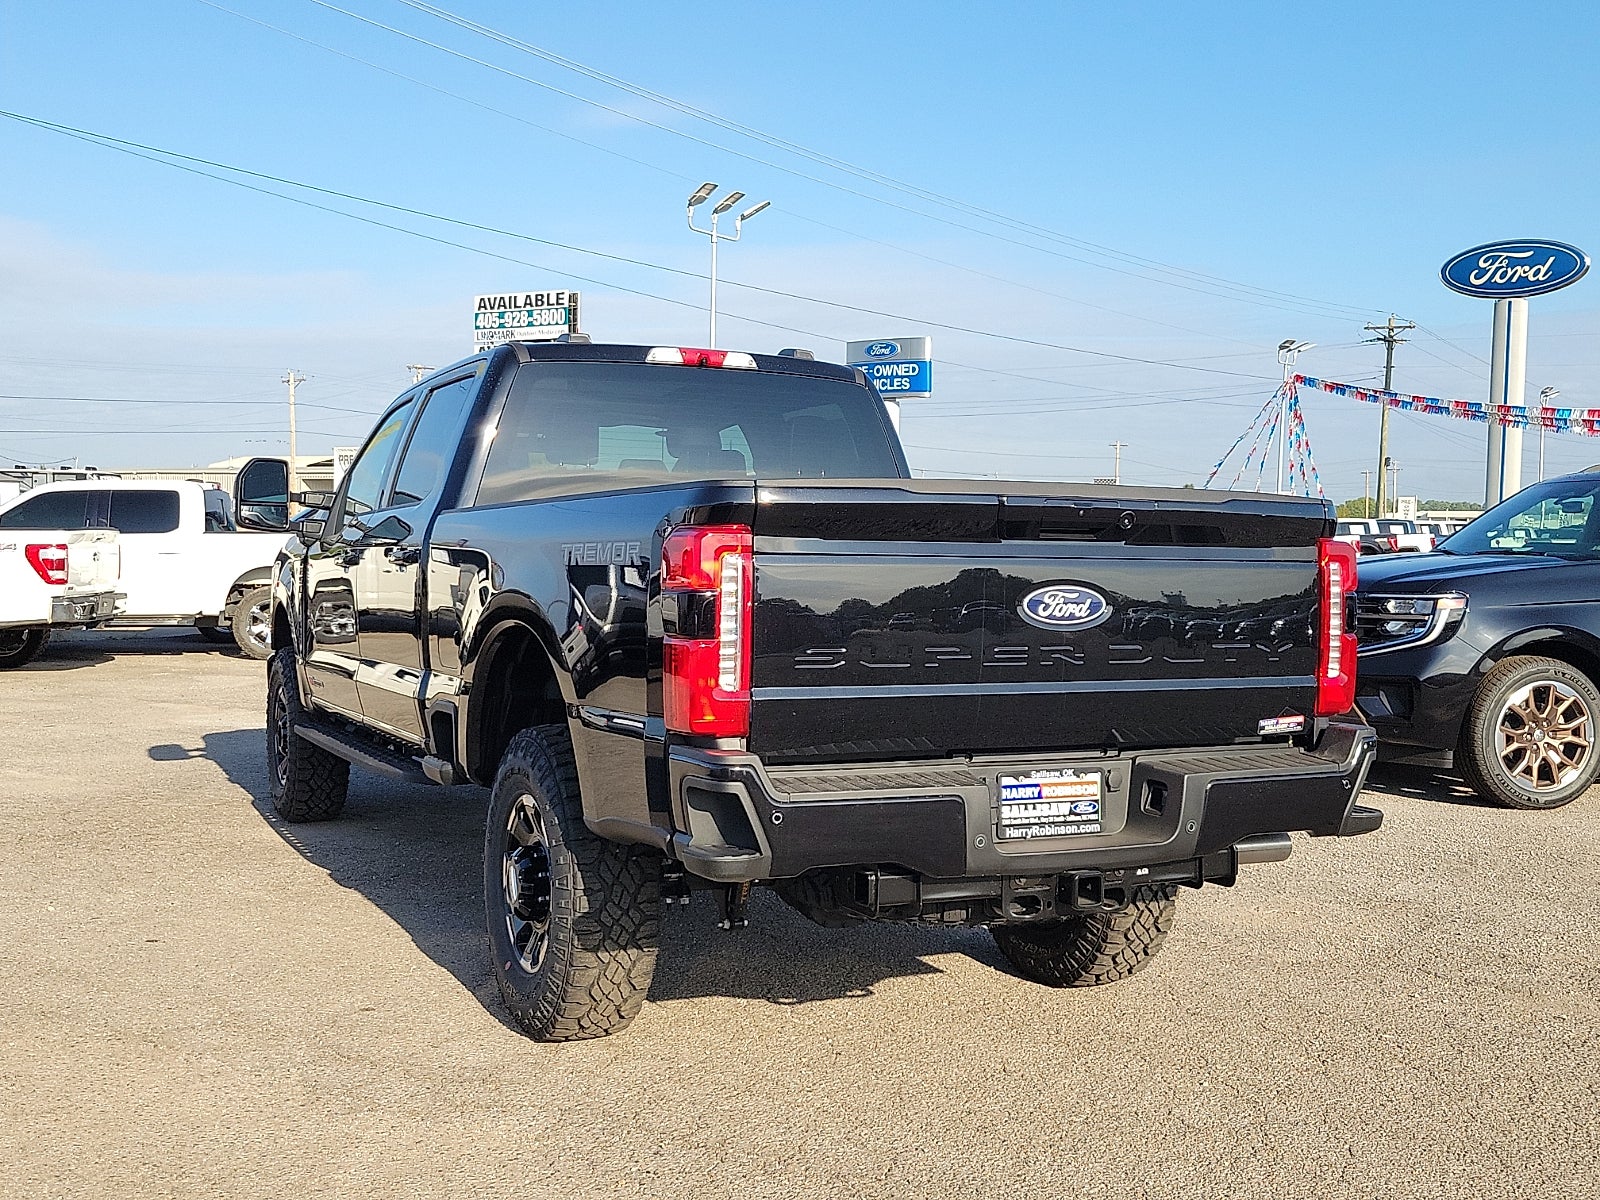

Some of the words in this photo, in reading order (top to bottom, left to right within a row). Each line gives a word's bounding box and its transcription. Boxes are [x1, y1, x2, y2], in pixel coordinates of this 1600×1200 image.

[1469, 250, 1556, 286] Ford
[477, 291, 565, 311] AVAILABLE
[475, 308, 566, 329] 405-928-5800
[870, 343, 891, 356] Ford
[857, 363, 919, 377] E-OWNED
[561, 541, 642, 566] TREMOR
[1038, 590, 1093, 618] Ford
[794, 645, 1085, 668] SUPER
[1108, 642, 1293, 665] DUTY
[1062, 768, 1075, 777] OK
[1002, 786, 1041, 799] HARRY
[1043, 784, 1098, 798] ROBINSON
[1002, 801, 1071, 818] SALLISAW
[1006, 823, 1101, 839] HarryRobinson.com
